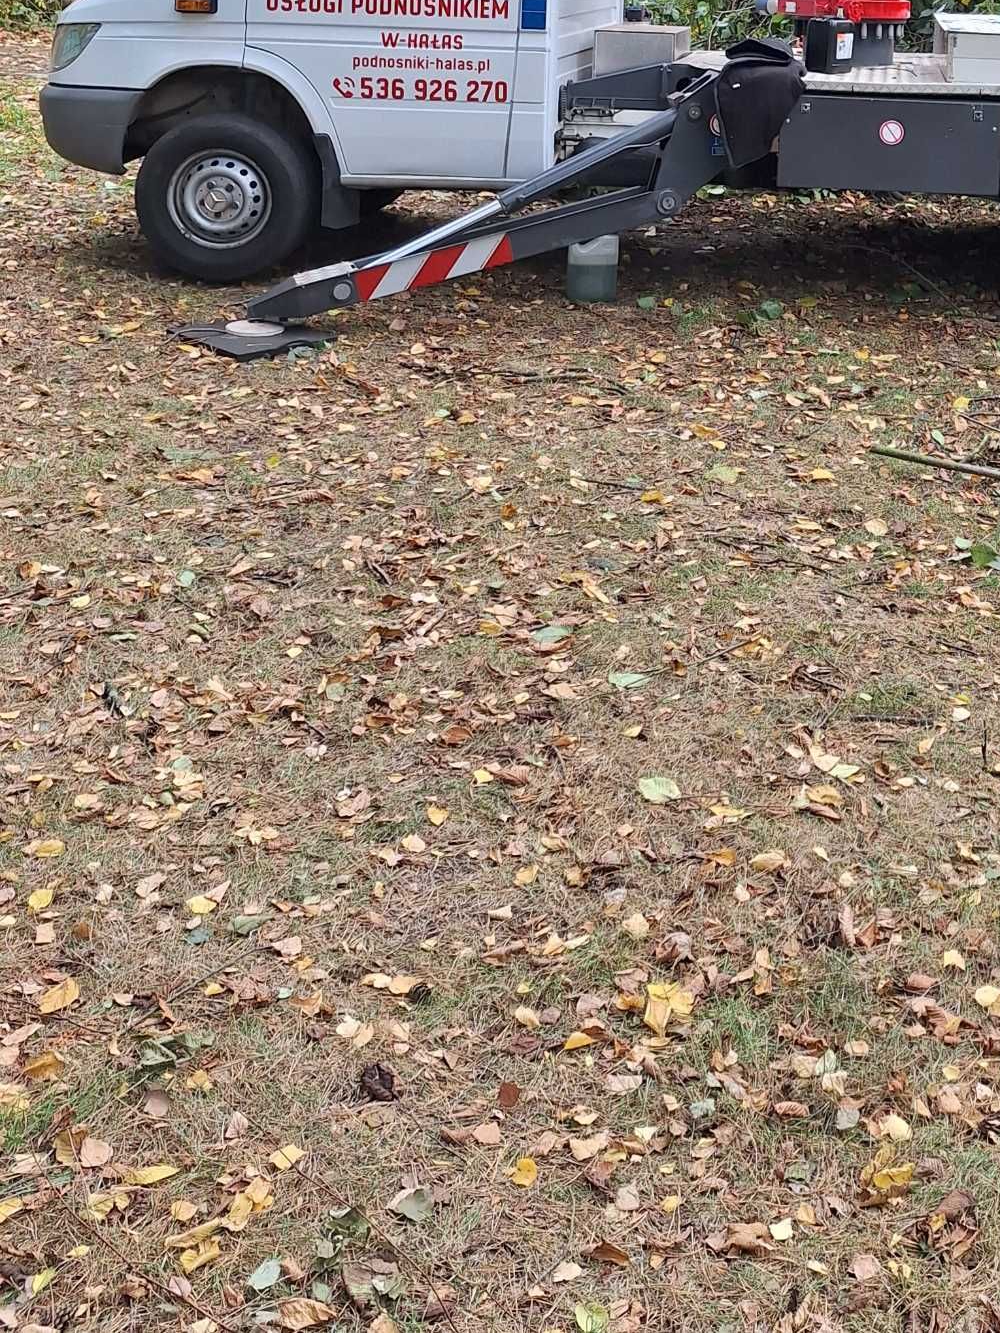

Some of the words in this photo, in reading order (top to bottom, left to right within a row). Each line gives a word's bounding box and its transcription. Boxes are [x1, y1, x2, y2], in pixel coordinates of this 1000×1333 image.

[381, 32, 464, 50] W-HAŁAS
[352, 55, 490, 73] podnosniki-halas.pl
[360, 77, 405, 100] 536
[415, 79, 458, 102] 926
[467, 80, 509, 103] 270
